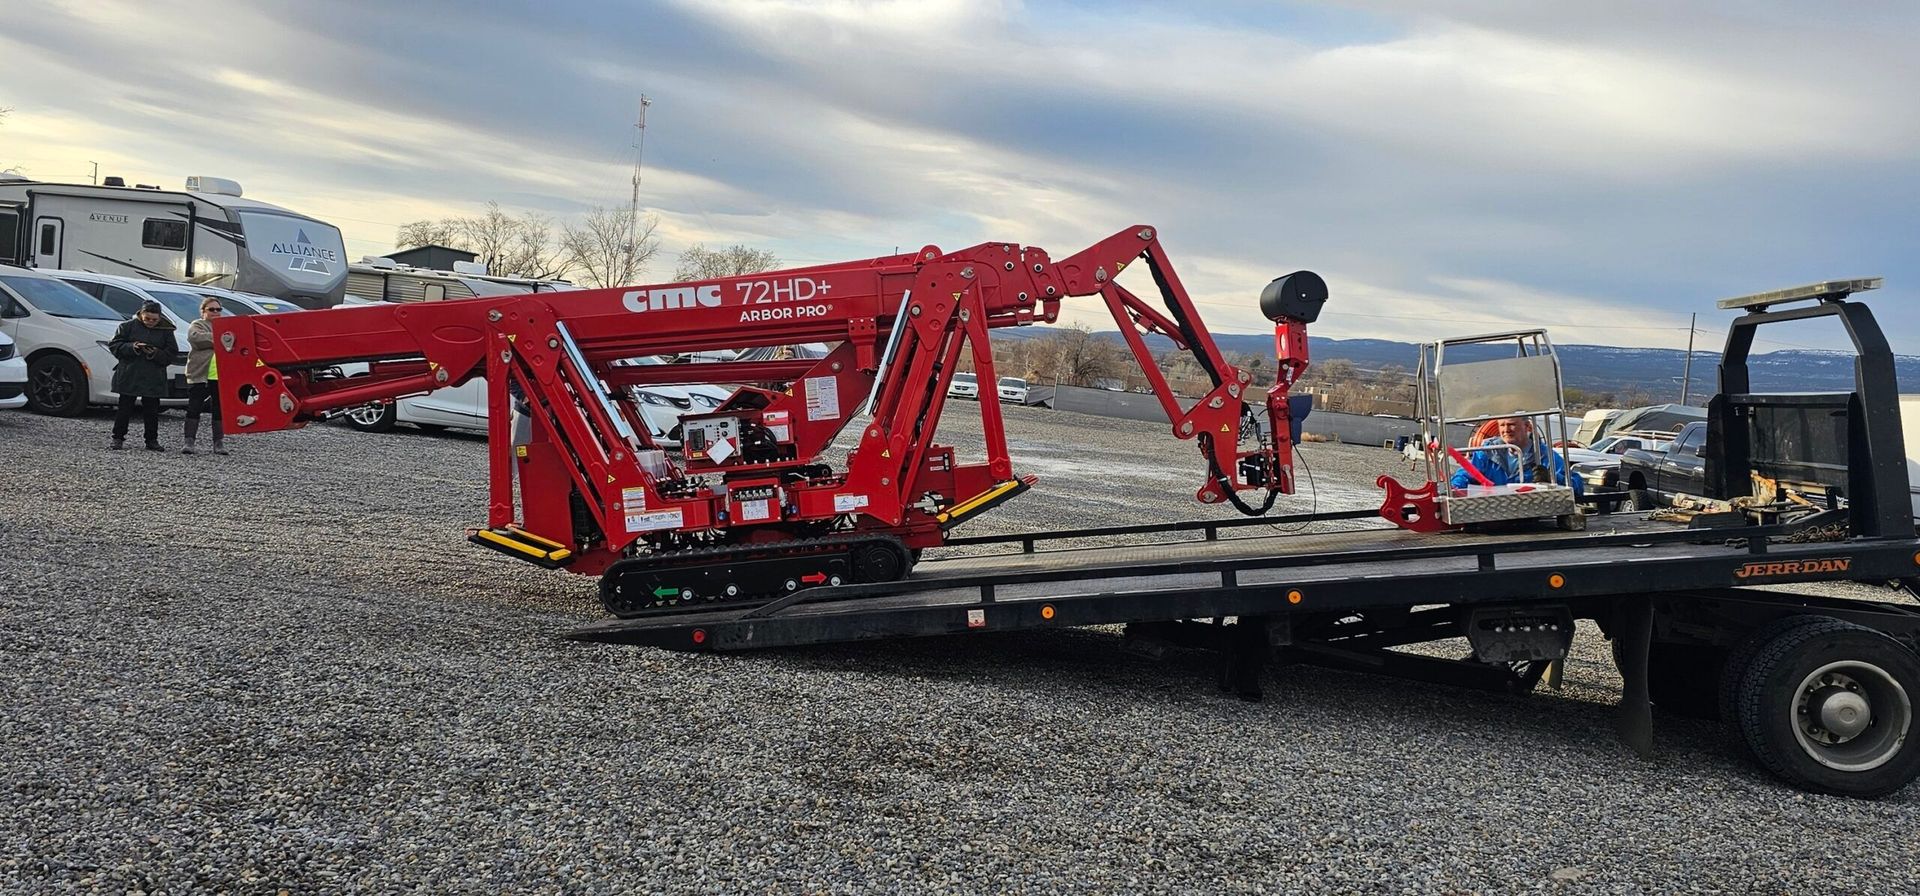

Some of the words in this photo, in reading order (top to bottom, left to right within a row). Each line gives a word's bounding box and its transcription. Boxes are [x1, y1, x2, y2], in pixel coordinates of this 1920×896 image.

[89, 213, 129, 224] AVENUE
[271, 242, 336, 262] ALLIANCE
[736, 277, 831, 305] 72HD+
[740, 307, 793, 322] ARBOR
[1735, 558, 1851, 578] JERR-DAN
